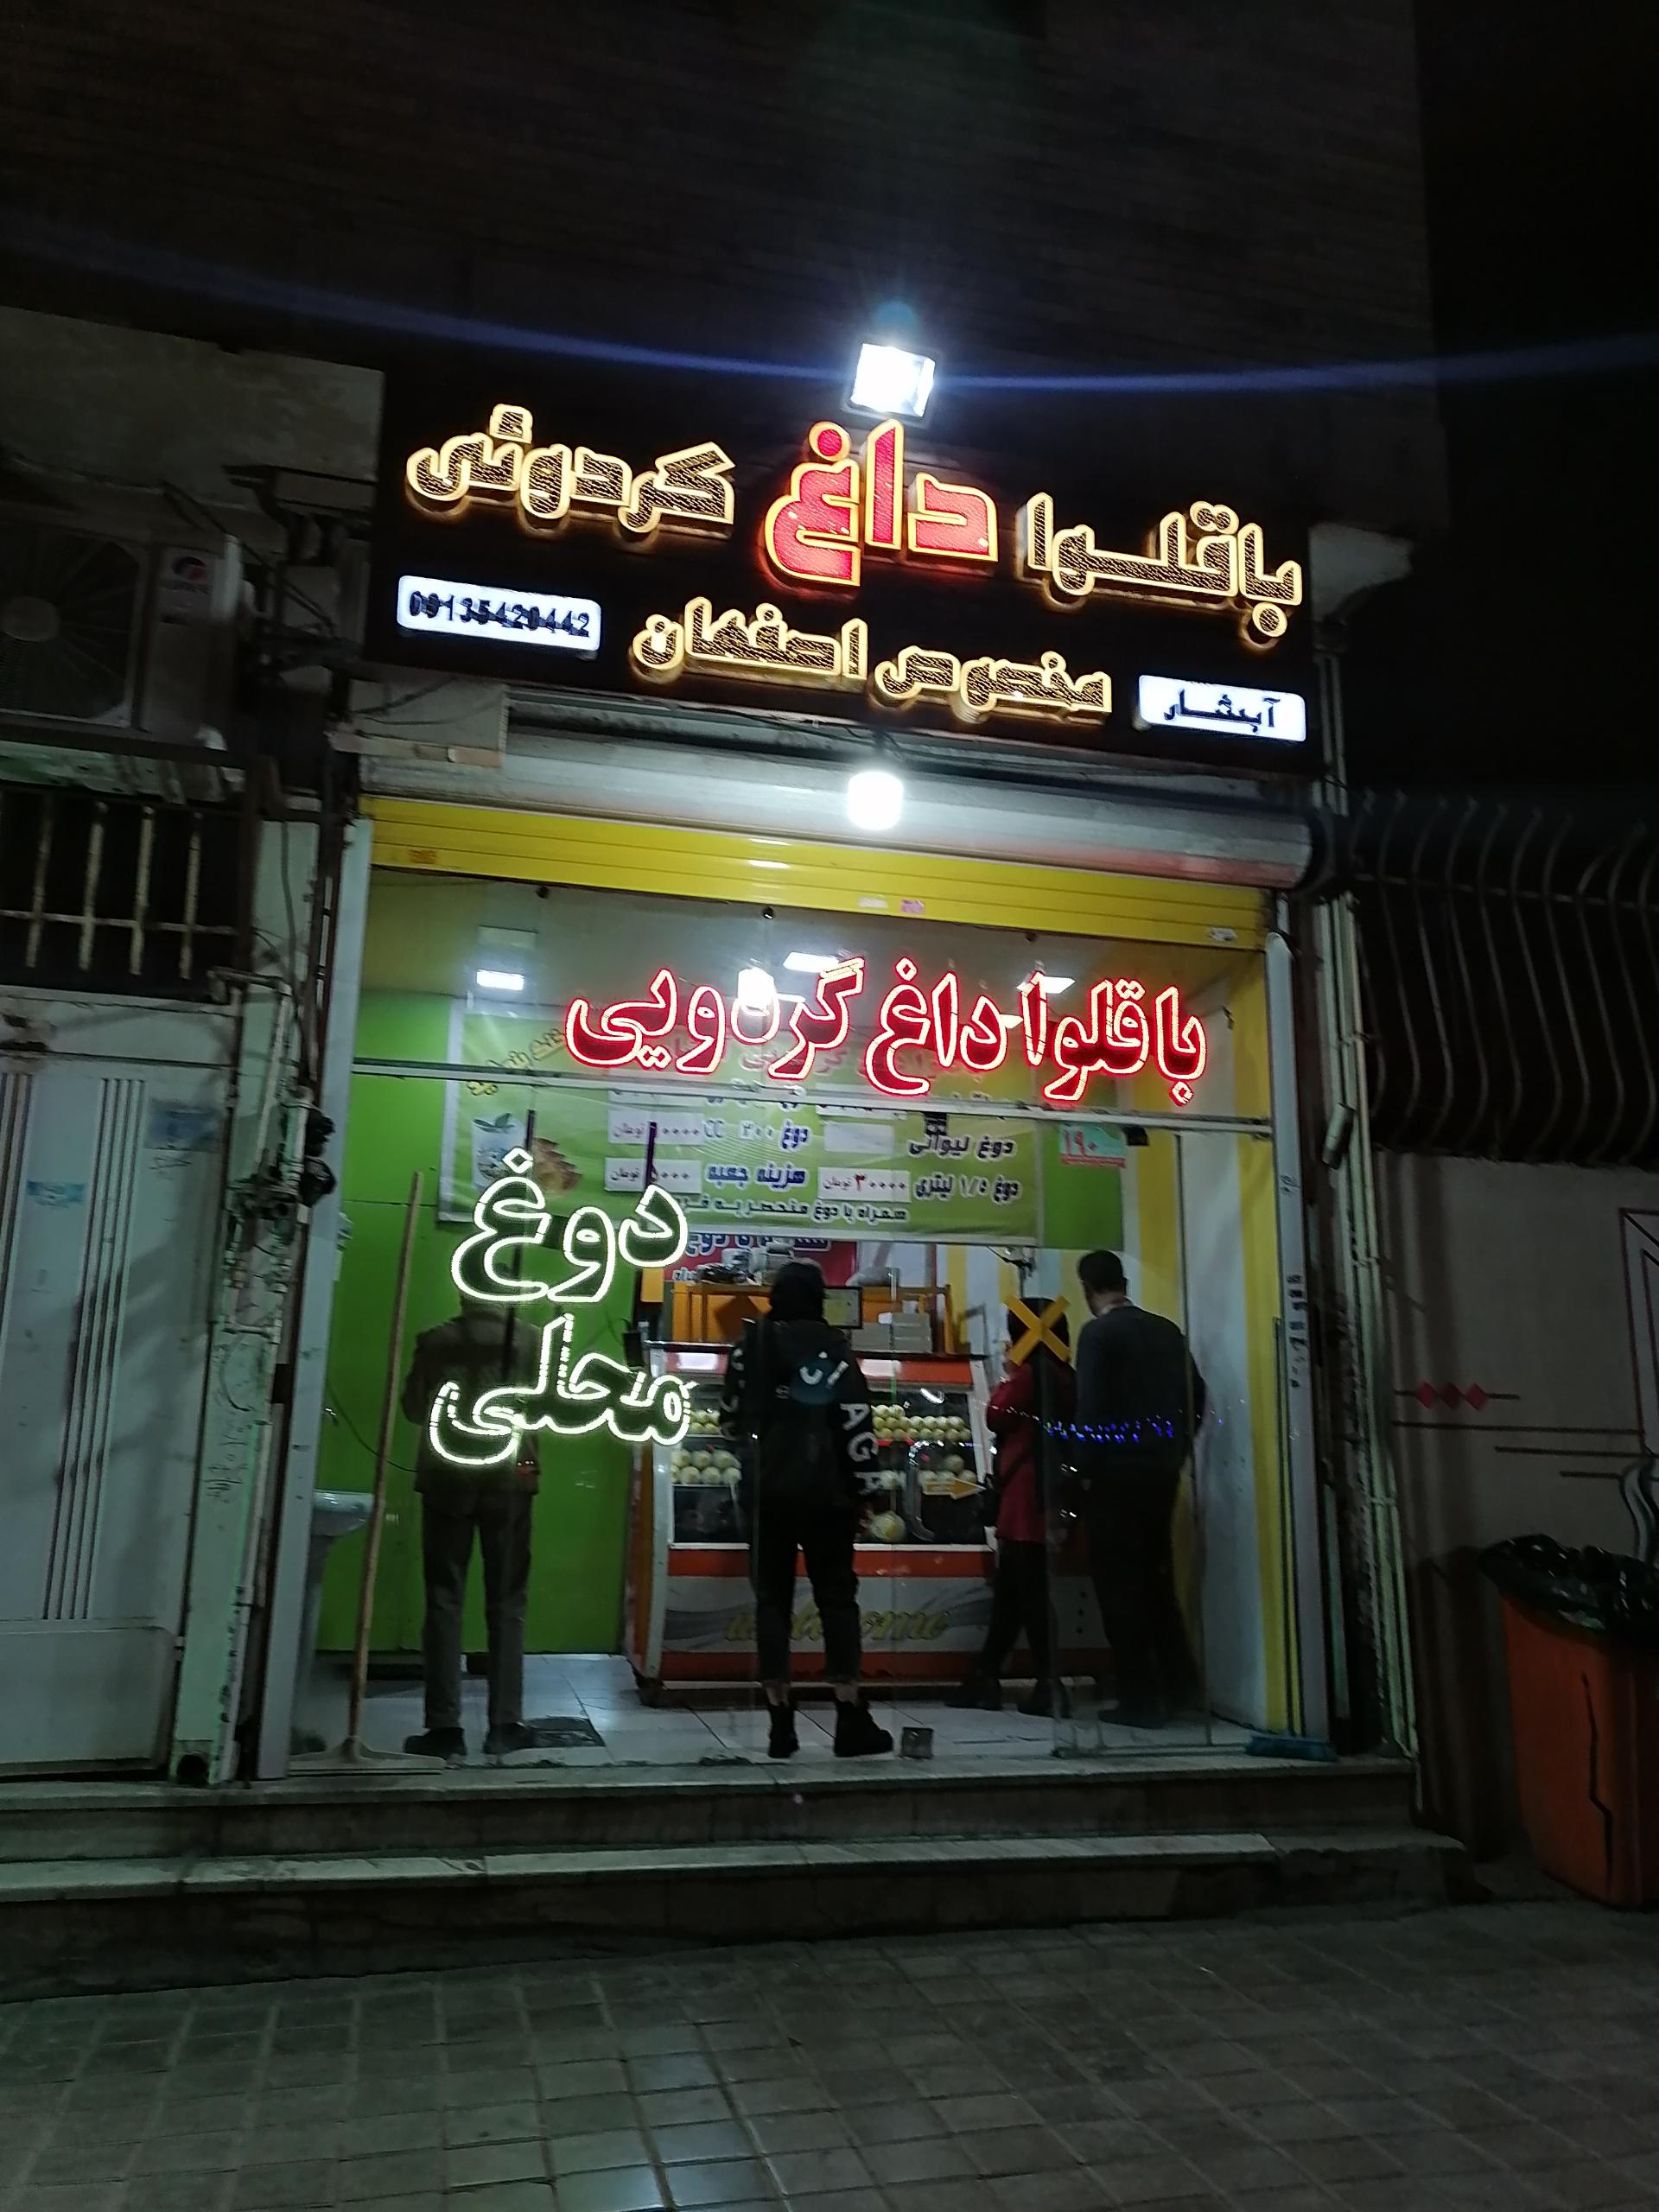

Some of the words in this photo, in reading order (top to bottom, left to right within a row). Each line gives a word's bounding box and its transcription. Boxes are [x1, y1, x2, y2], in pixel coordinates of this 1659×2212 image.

[764, 418, 999, 587] داغ
[1026, 493, 1302, 638] باقلوا
[632, 596, 868, 681] اصفهان
[874, 645, 1112, 713] مخصوص
[1164, 688, 1281, 733] آبشار
[865, 957, 1009, 1096] داغ
[1020, 969, 1207, 1105] باقلوا
[781, 1119, 810, 1149] دوغ
[976, 1135, 1014, 1160] دوغ
[756, 1163, 807, 1190] هزینه
[813, 1200, 839, 1221] دوغ
[993, 1174, 1020, 1202] دوغ
[451, 1147, 689, 1302] دوغ
[429, 1313, 693, 1465] محلی
